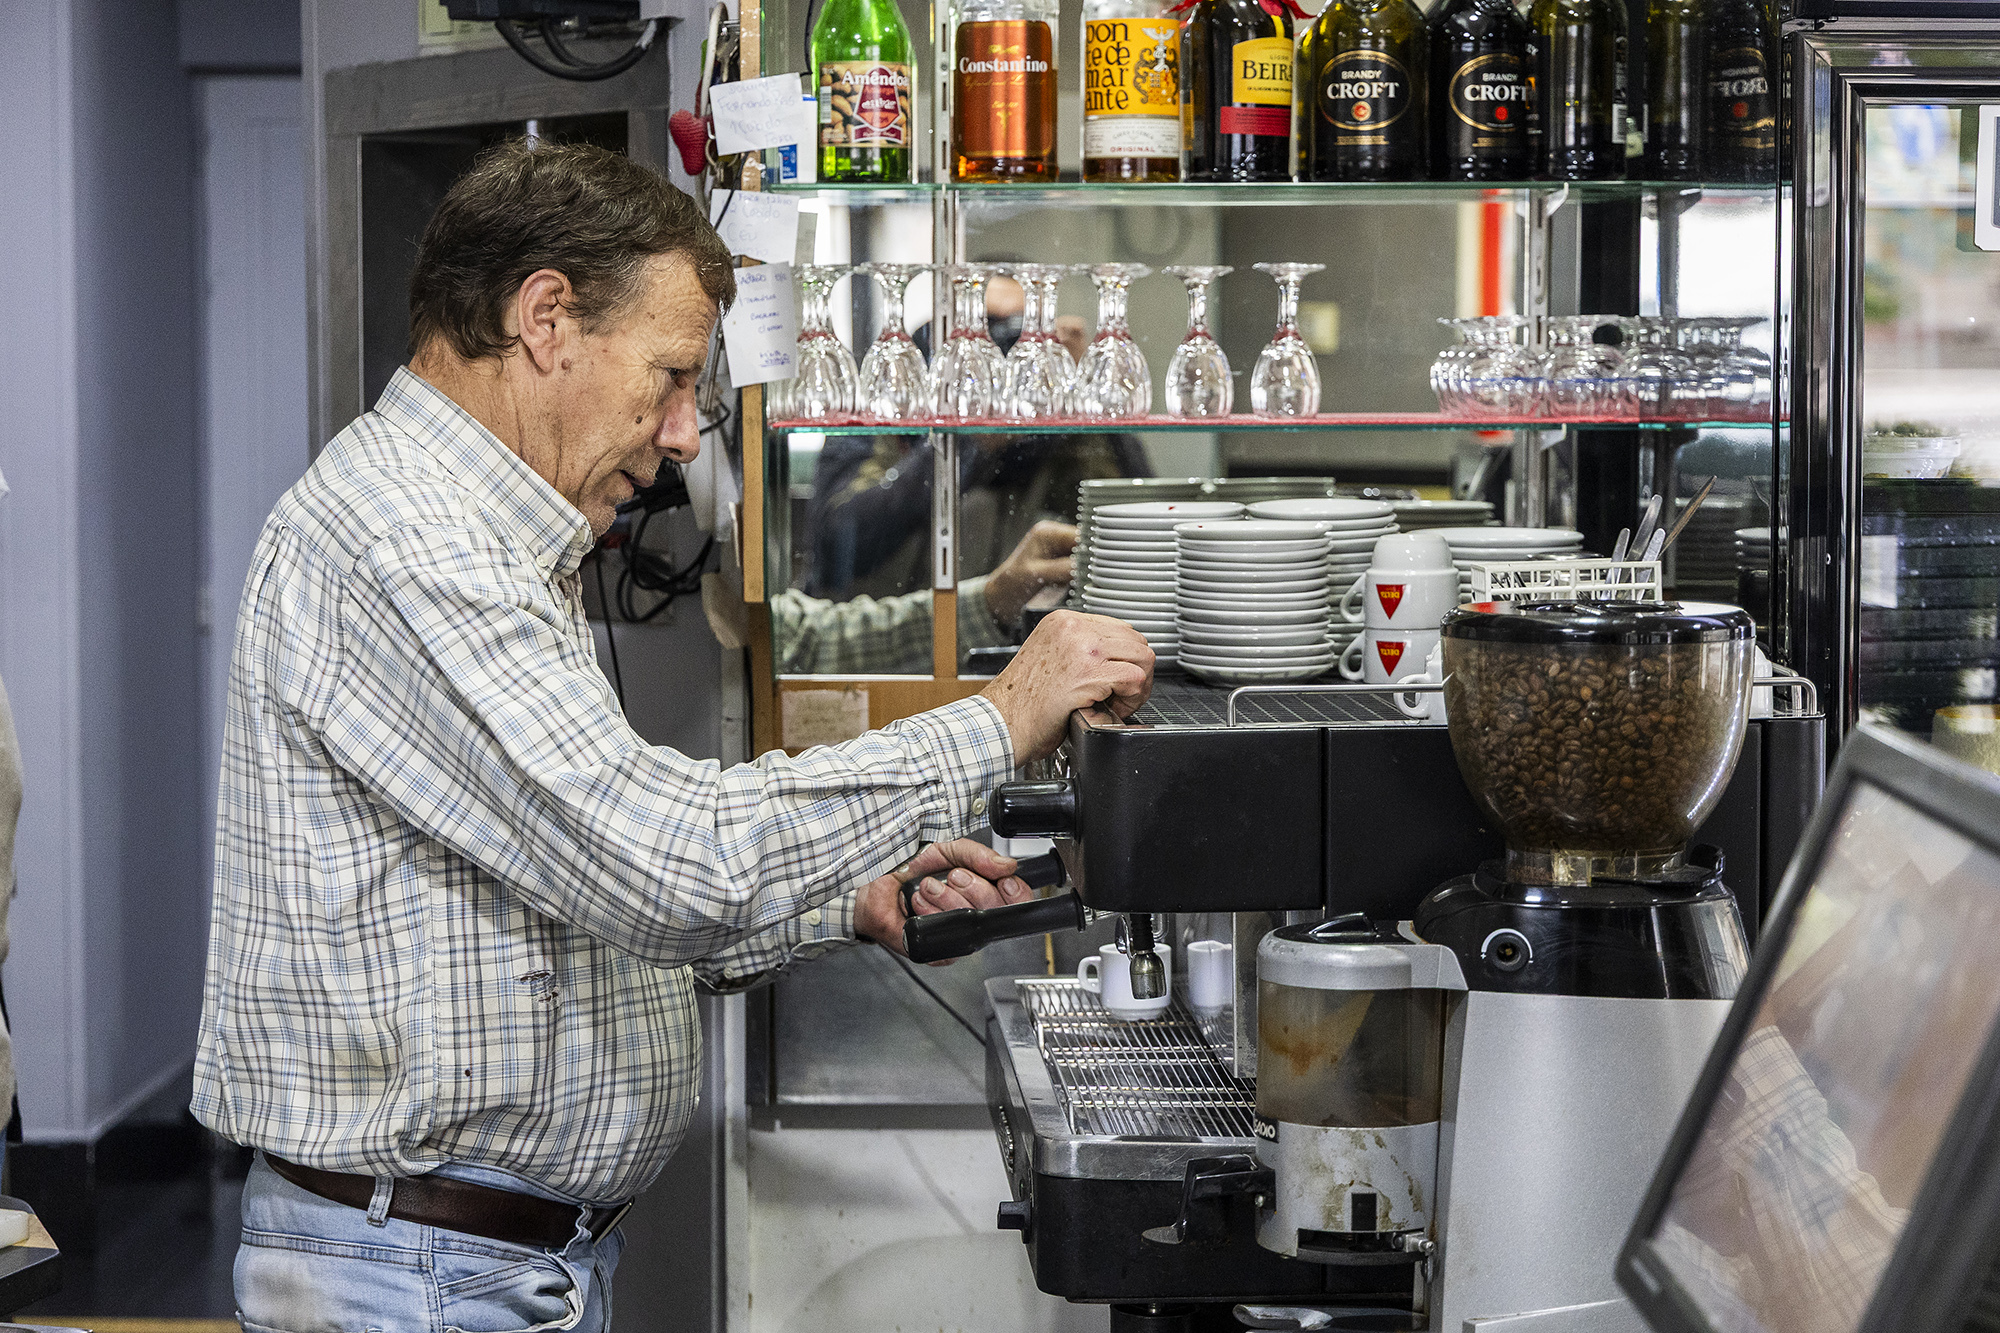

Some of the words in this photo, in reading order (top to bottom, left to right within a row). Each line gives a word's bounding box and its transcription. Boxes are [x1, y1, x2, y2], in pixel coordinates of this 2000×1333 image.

[959, 55, 1048, 74] Constantino
[1086, 67, 1129, 88] mar
[1341, 70, 1382, 80] BRANDY
[1482, 73, 1518, 82] BRANDY
[1326, 81, 1400, 100] CROFT
[1464, 84, 1528, 101] CROFT
[1086, 89, 1129, 111] ante
[1380, 591, 1400, 599] DELTA
[1380, 648, 1400, 656] DELTA
